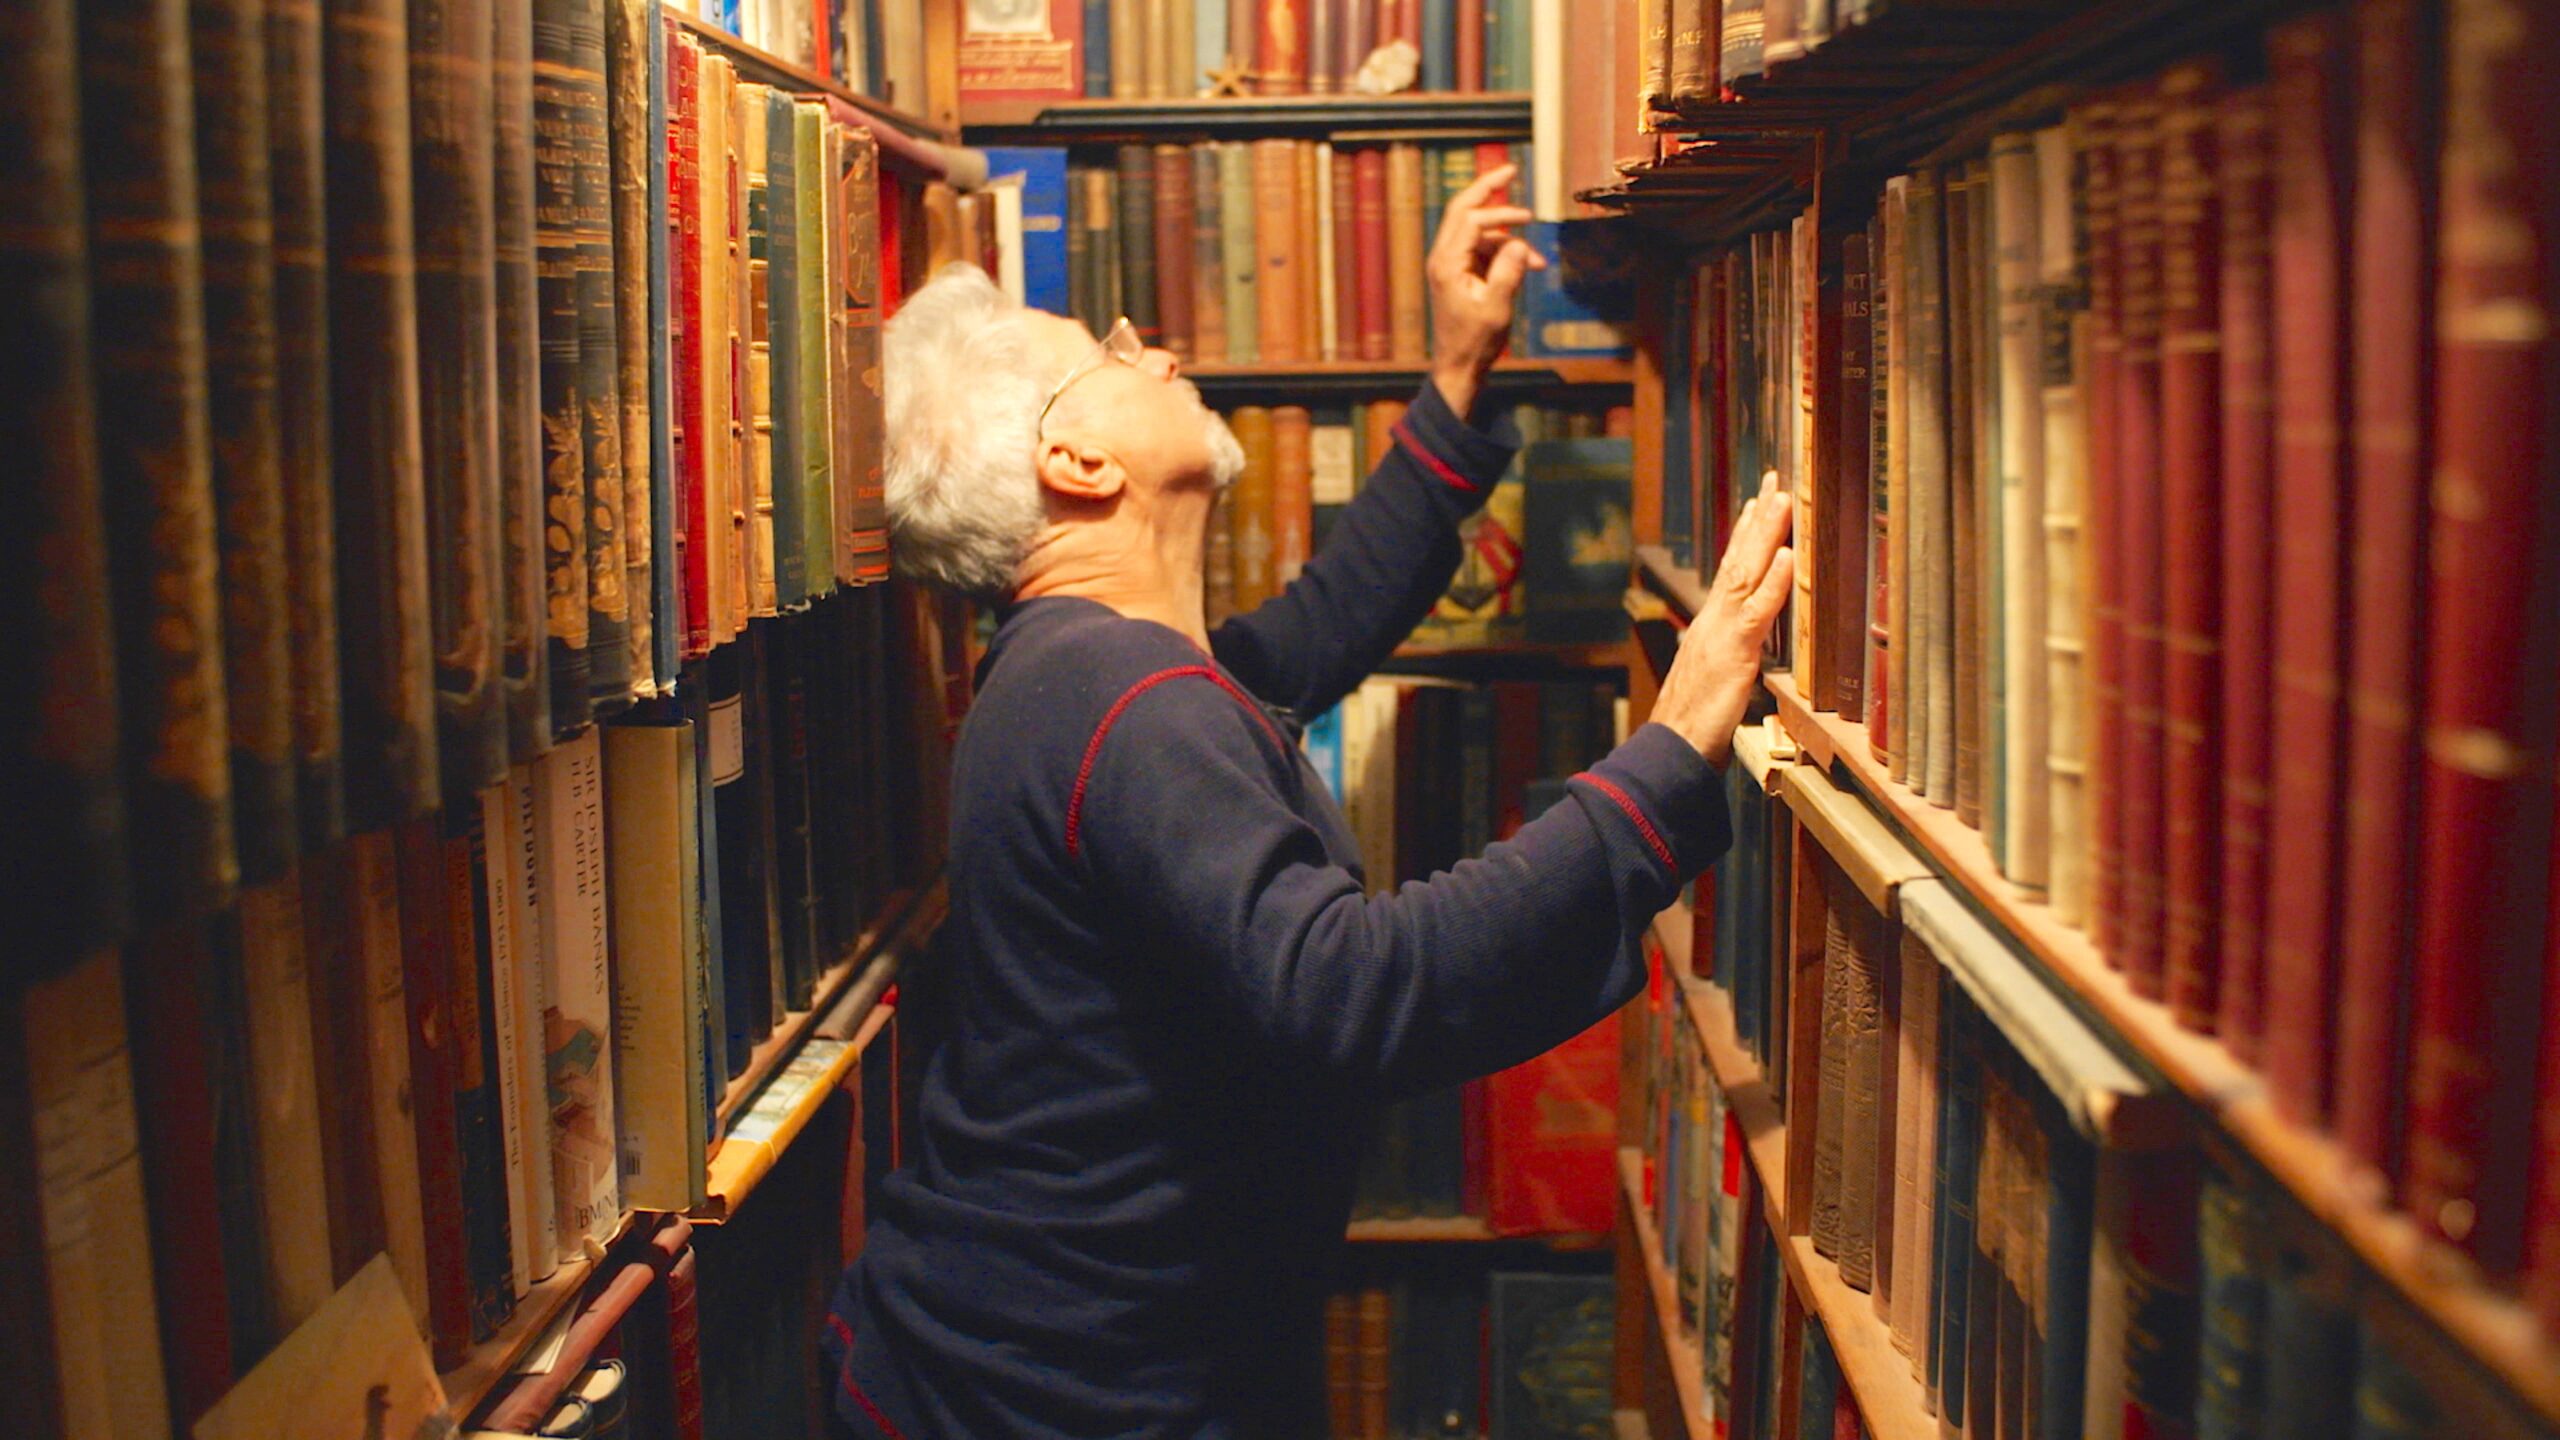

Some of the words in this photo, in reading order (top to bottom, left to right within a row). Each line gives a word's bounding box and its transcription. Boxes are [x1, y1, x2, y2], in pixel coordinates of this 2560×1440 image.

[584, 755, 597, 795] SIR
[521, 783, 541, 908] PILTDOWN
[574, 810, 589, 898] CARTER
[585, 802, 601, 897] JOSEPH
[591, 905, 604, 996] BANKS
[506, 1056, 518, 1134] Founders
